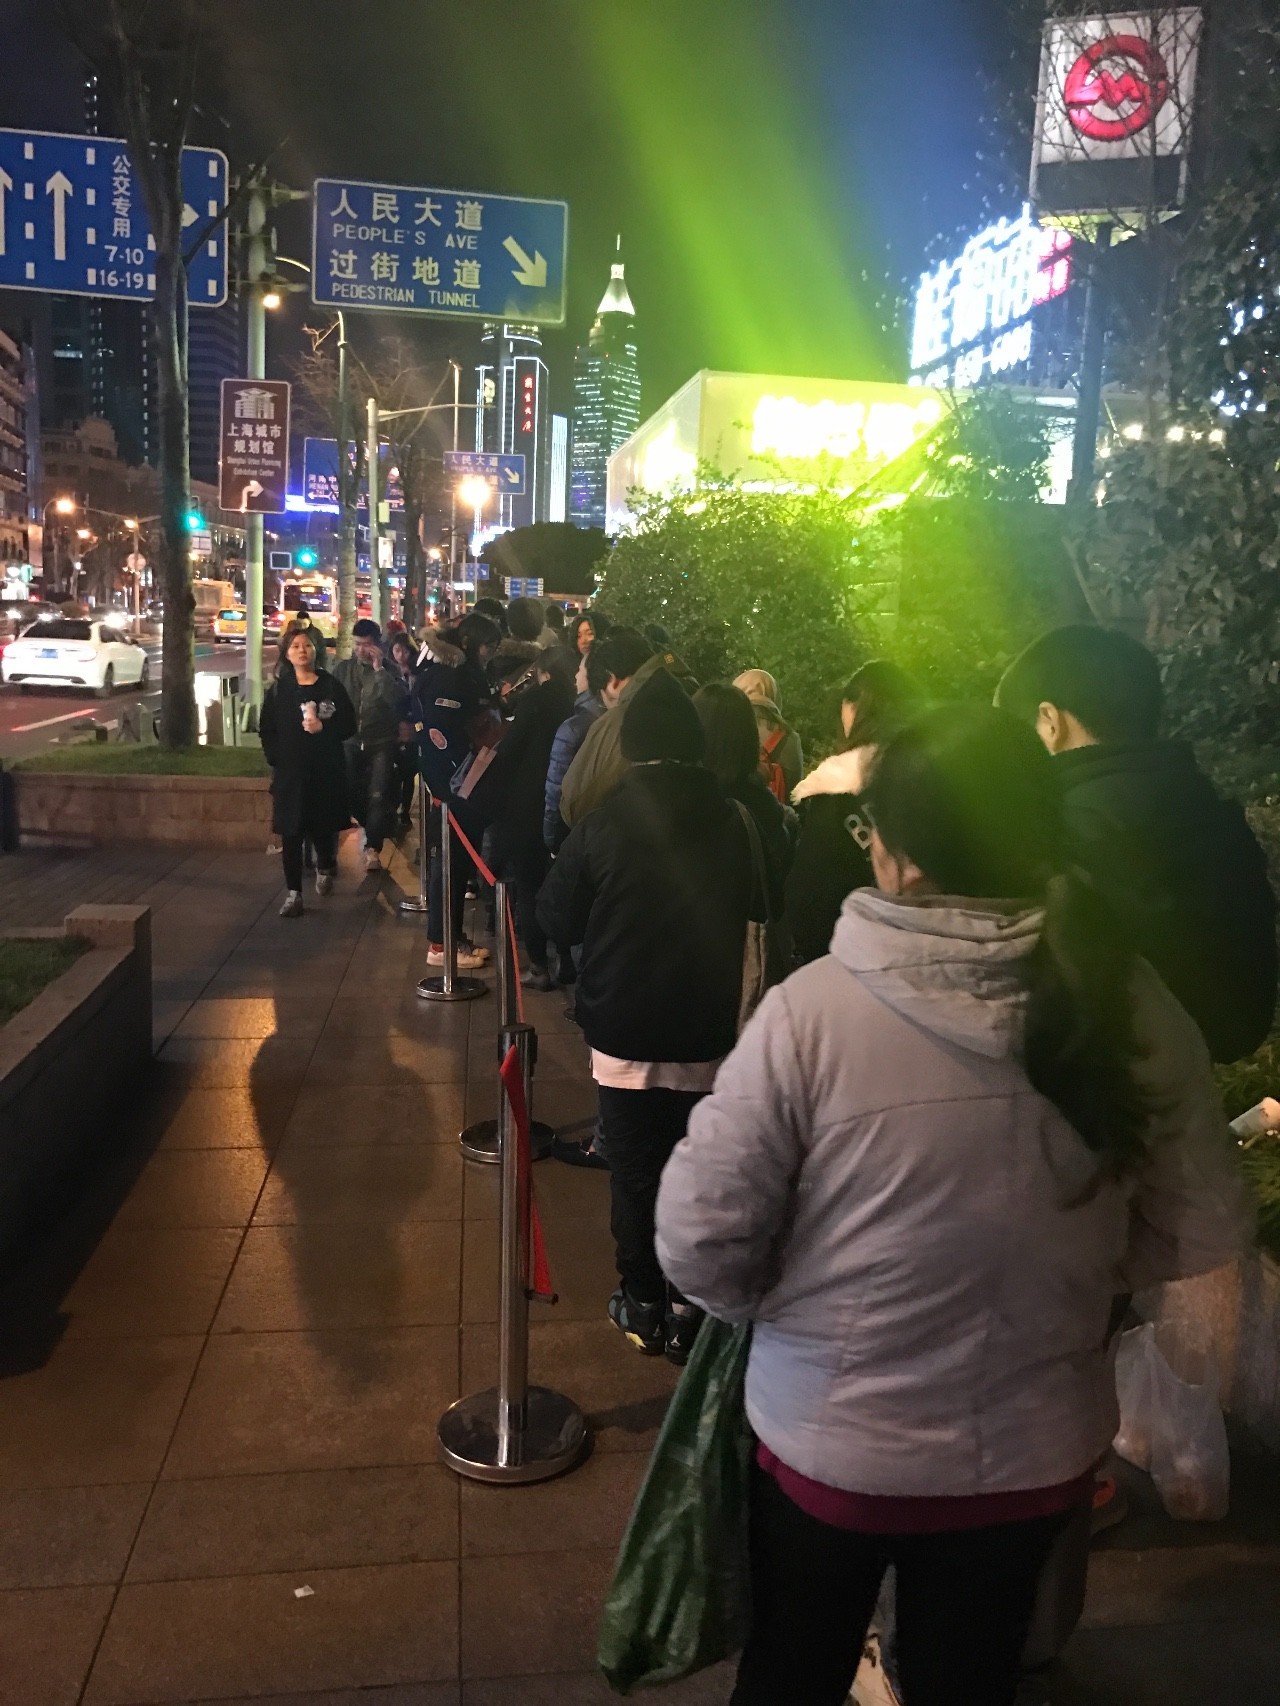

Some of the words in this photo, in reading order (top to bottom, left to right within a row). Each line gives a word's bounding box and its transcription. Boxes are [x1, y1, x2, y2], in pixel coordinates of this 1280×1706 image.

[112, 155, 132, 238] 公交专用
[330, 188, 484, 231] 人民大道
[333, 223, 426, 246] PEOPLE'S
[445, 233, 479, 250] AVE
[104, 245, 144, 265] 7-10
[100, 270, 144, 289] 16-19
[329, 249, 482, 290] 过街地道
[331, 282, 415, 304] PEDESTRIAN
[428, 289, 481, 309] TUNNEL
[451, 454, 499, 467] 人民大道
